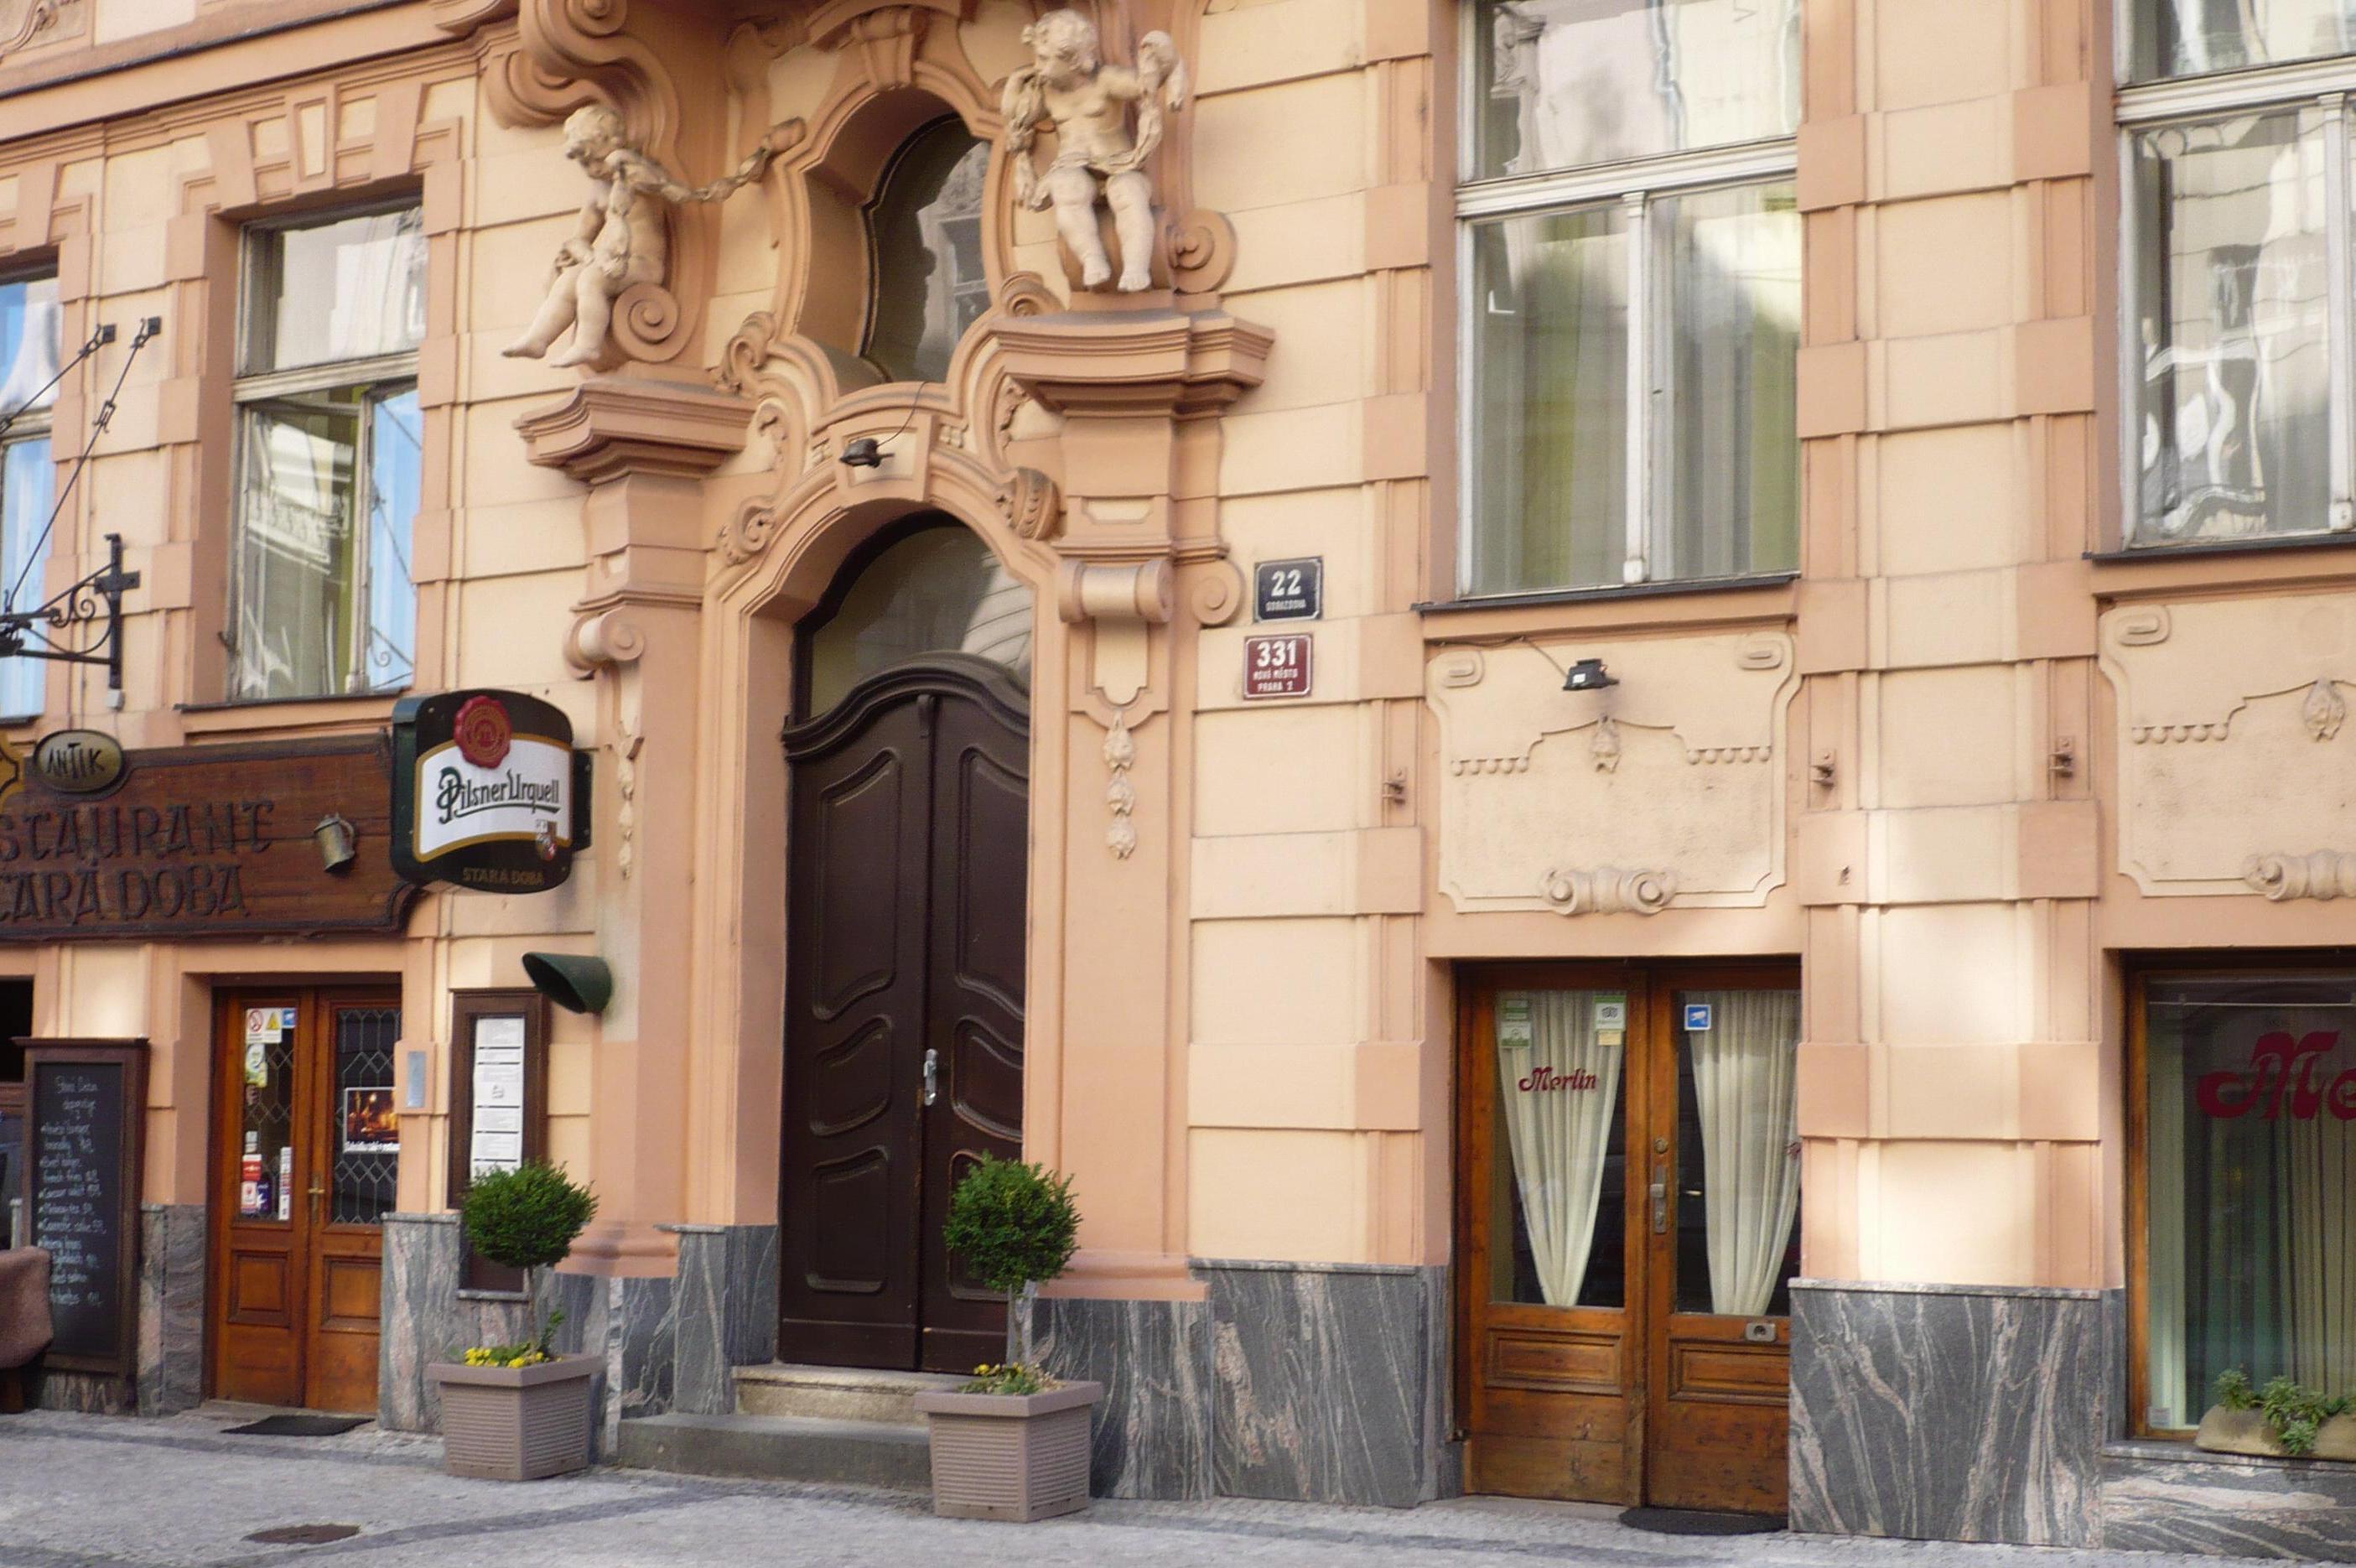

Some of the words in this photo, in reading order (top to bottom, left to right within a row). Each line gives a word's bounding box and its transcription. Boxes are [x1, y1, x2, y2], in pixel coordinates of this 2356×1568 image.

[1271, 569, 1301, 597] 22
[1257, 640, 1296, 667] 331
[1257, 681, 1283, 692] PRAHA
[46, 742, 106, 779] ANTIK
[436, 766, 508, 825] Pilsner
[506, 769, 560, 814] Urquell
[117, 861, 250, 921] DOBA
[1518, 1066, 1597, 1092] Merlin
